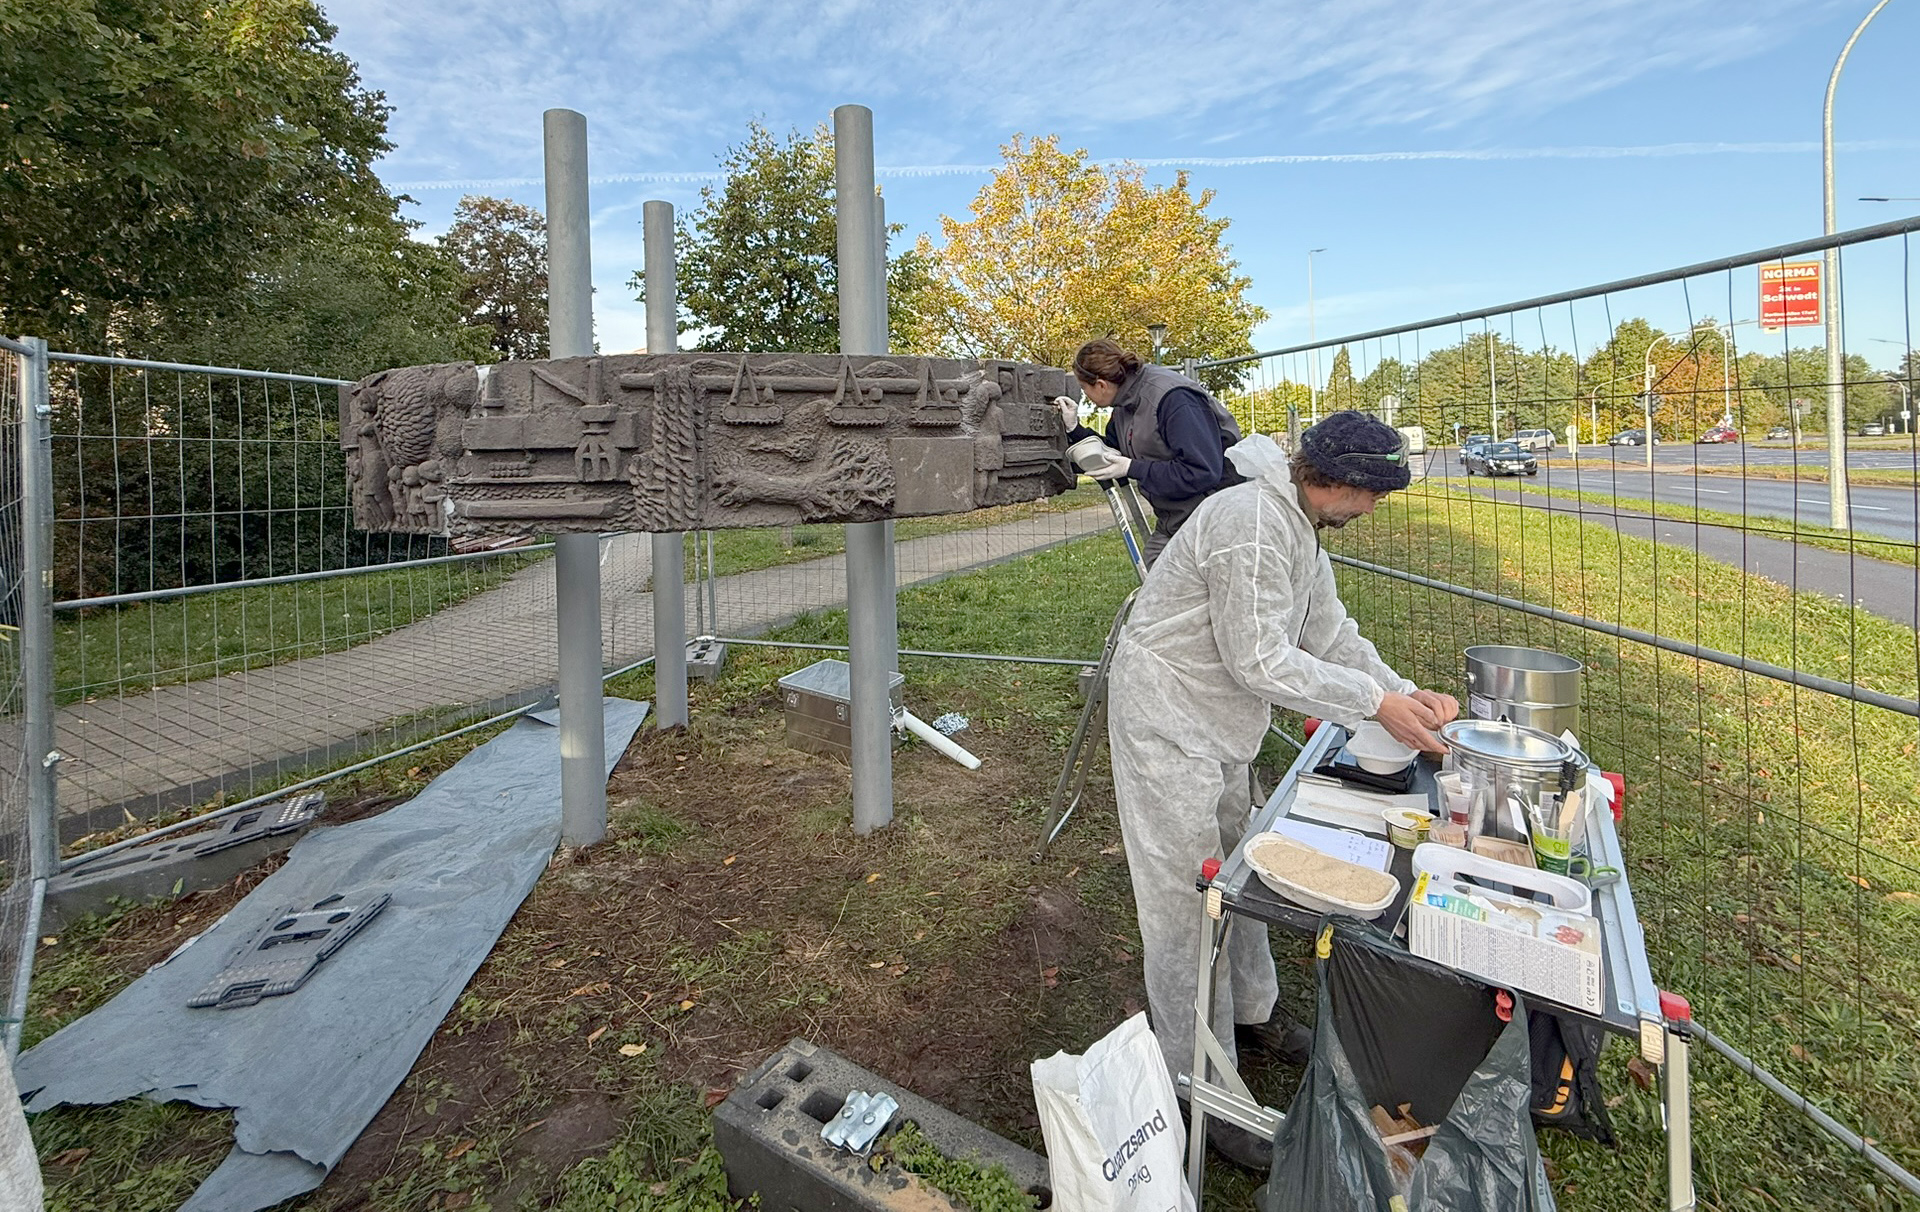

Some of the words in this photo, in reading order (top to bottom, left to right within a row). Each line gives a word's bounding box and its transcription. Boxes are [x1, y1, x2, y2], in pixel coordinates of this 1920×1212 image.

[1764, 267, 1815, 279] NORMA
[1762, 292, 1817, 302] Schwedt
[1102, 1109, 1168, 1182] Quarzsand
